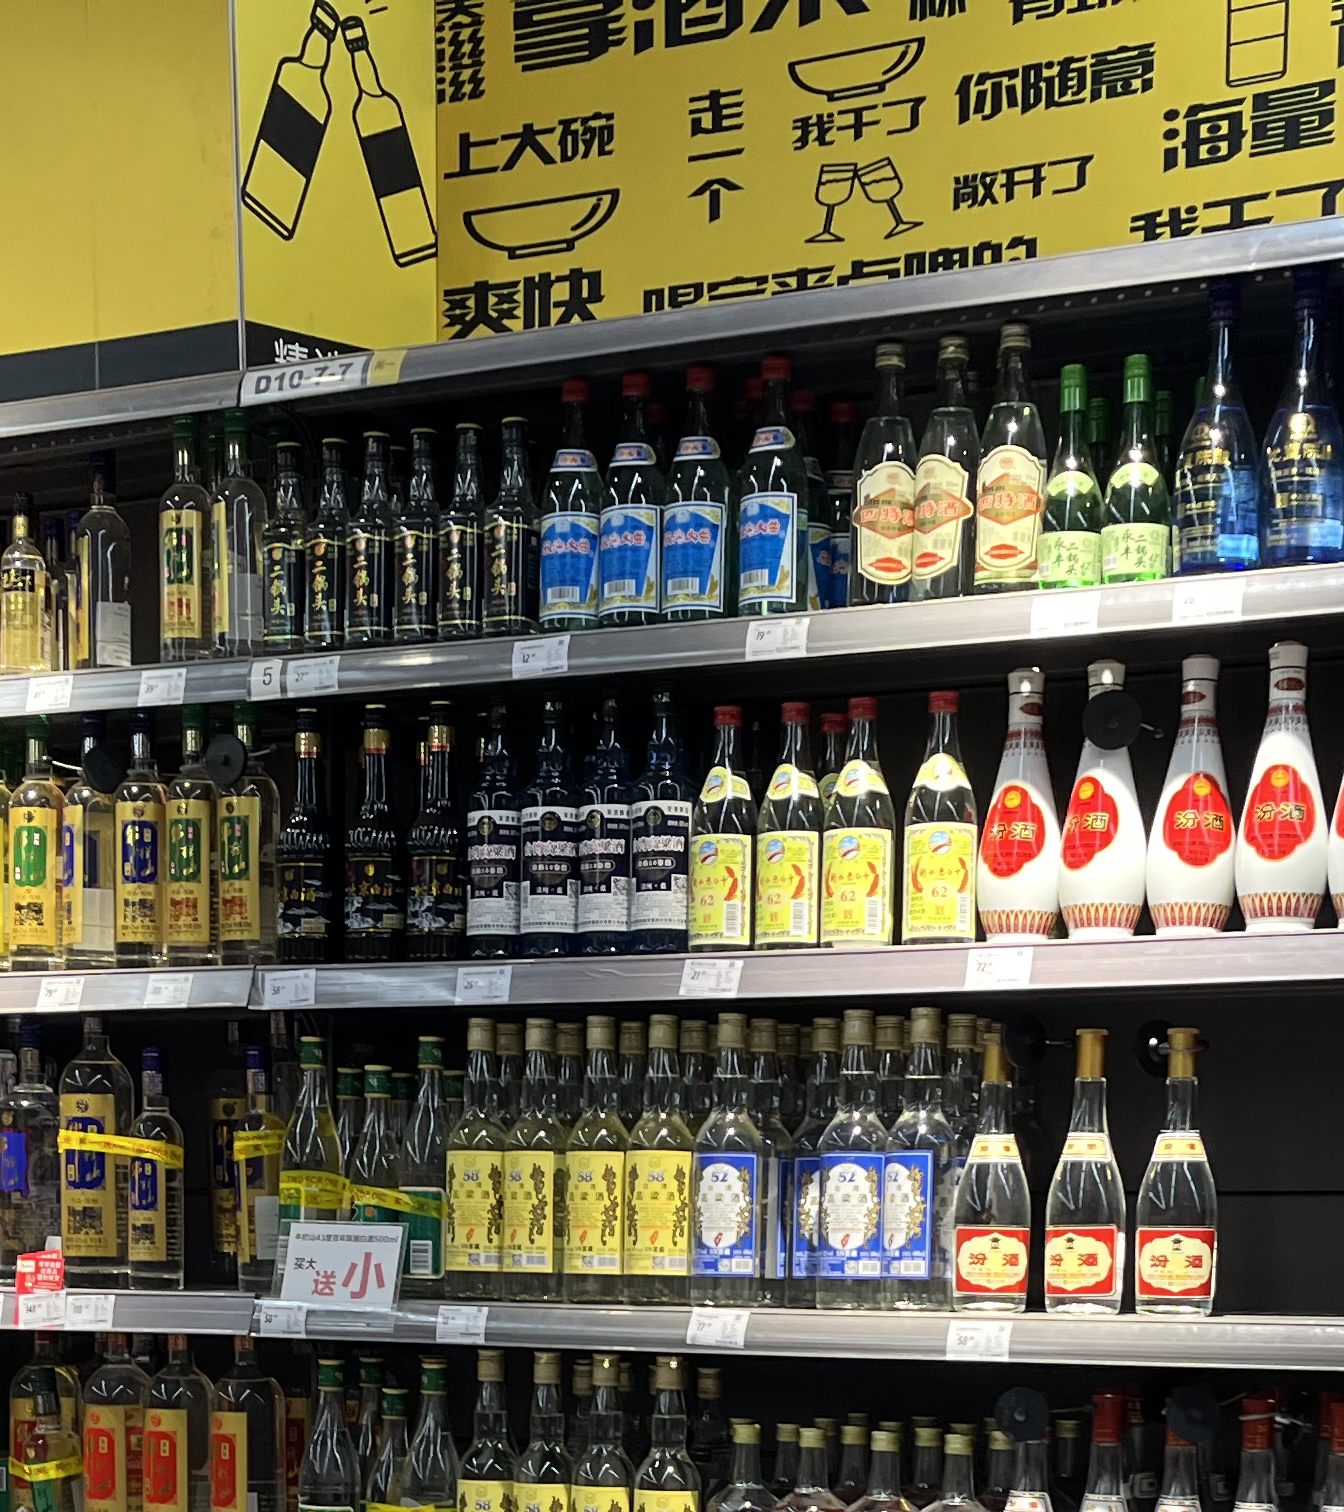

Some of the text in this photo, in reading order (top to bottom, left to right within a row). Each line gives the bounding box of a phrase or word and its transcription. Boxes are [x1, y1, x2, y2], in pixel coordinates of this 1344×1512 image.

[955, 41, 1158, 126] 你随意
[792, 95, 928, 152] 我干了
[1162, 78, 1337, 173] 海量
[443, 111, 615, 181] 上大碗
[687, 88, 745, 224] 走一个
[952, 154, 1095, 212] 敞开了
[440, 266, 606, 341] 爽快
[254, 360, 354, 396] D10-7-7
[977, 491, 1038, 512] 四特酒
[262, 666, 273, 686] 5
[1174, 809, 1227, 832] 汾酒
[1254, 801, 1307, 823] 汾酒
[989, 821, 1036, 842] 汾酒
[700, 895, 715, 906] 62
[766, 893, 781, 905] 62
[840, 890, 856, 903] 62
[931, 886, 948, 898] 62
[711, 1171, 728, 1183] 52
[838, 1169, 857, 1183] 52
[293, 1256, 317, 1271] 买大
[969, 1252, 1020, 1269] 汾酒
[1050, 1251, 1098, 1268] 汾酒
[1151, 1253, 1204, 1270] 汾酒
[474, 1499, 492, 1511] 58
